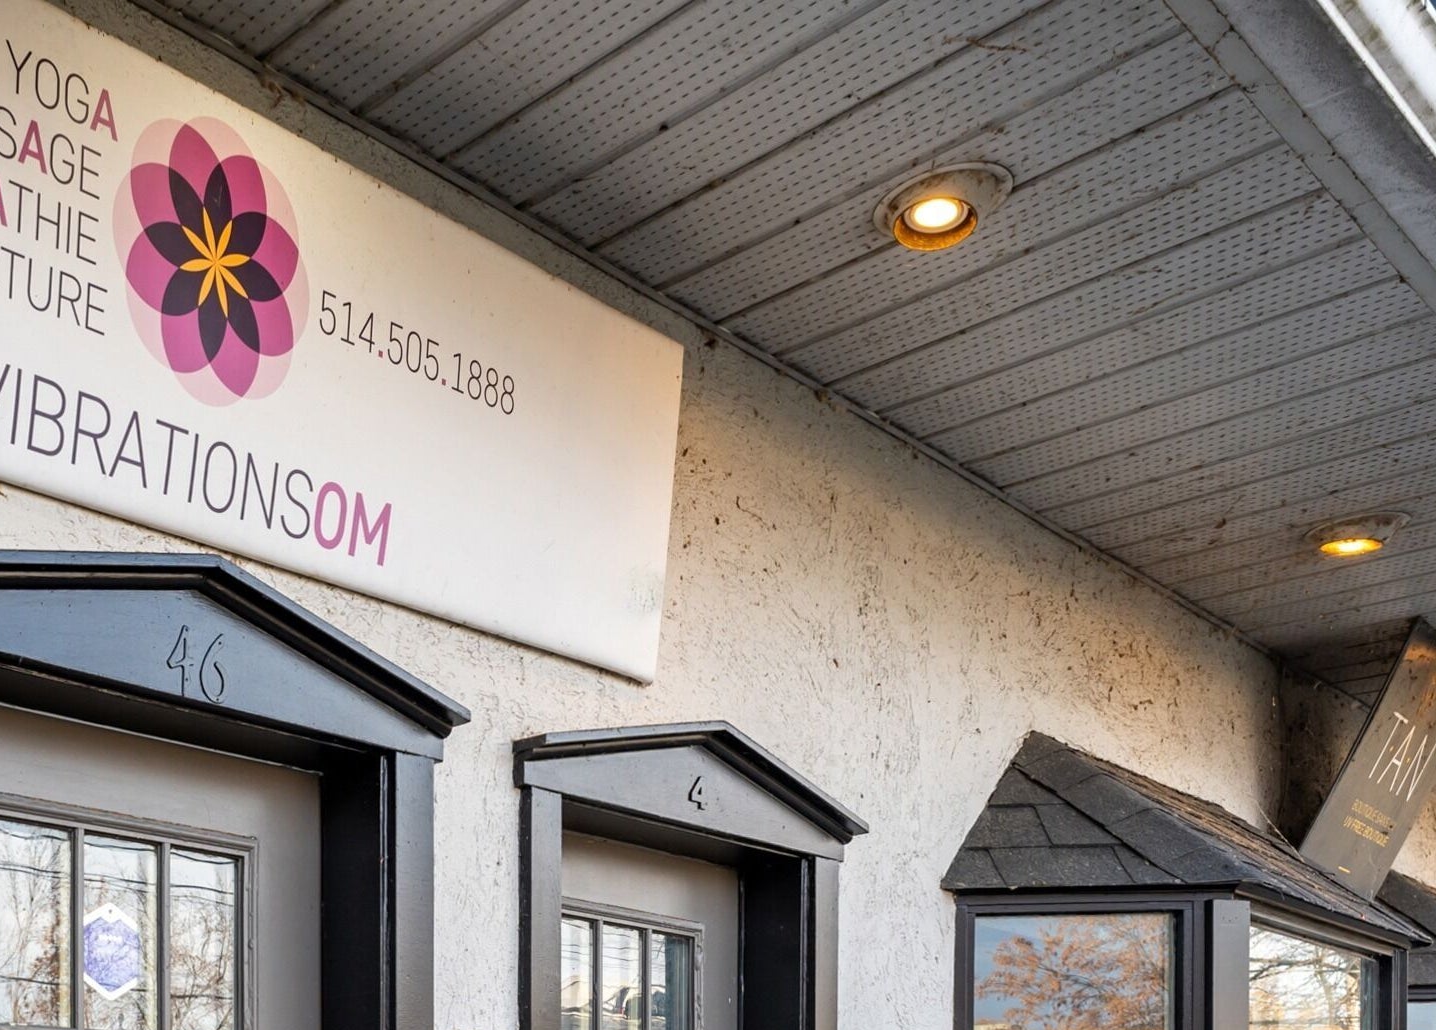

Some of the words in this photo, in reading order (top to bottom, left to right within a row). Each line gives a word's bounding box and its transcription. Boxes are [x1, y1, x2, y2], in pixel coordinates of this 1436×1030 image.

[6, 39, 118, 142] YOGA
[319, 289, 516, 415] 514.505.1888
[166, 625, 225, 703] 46
